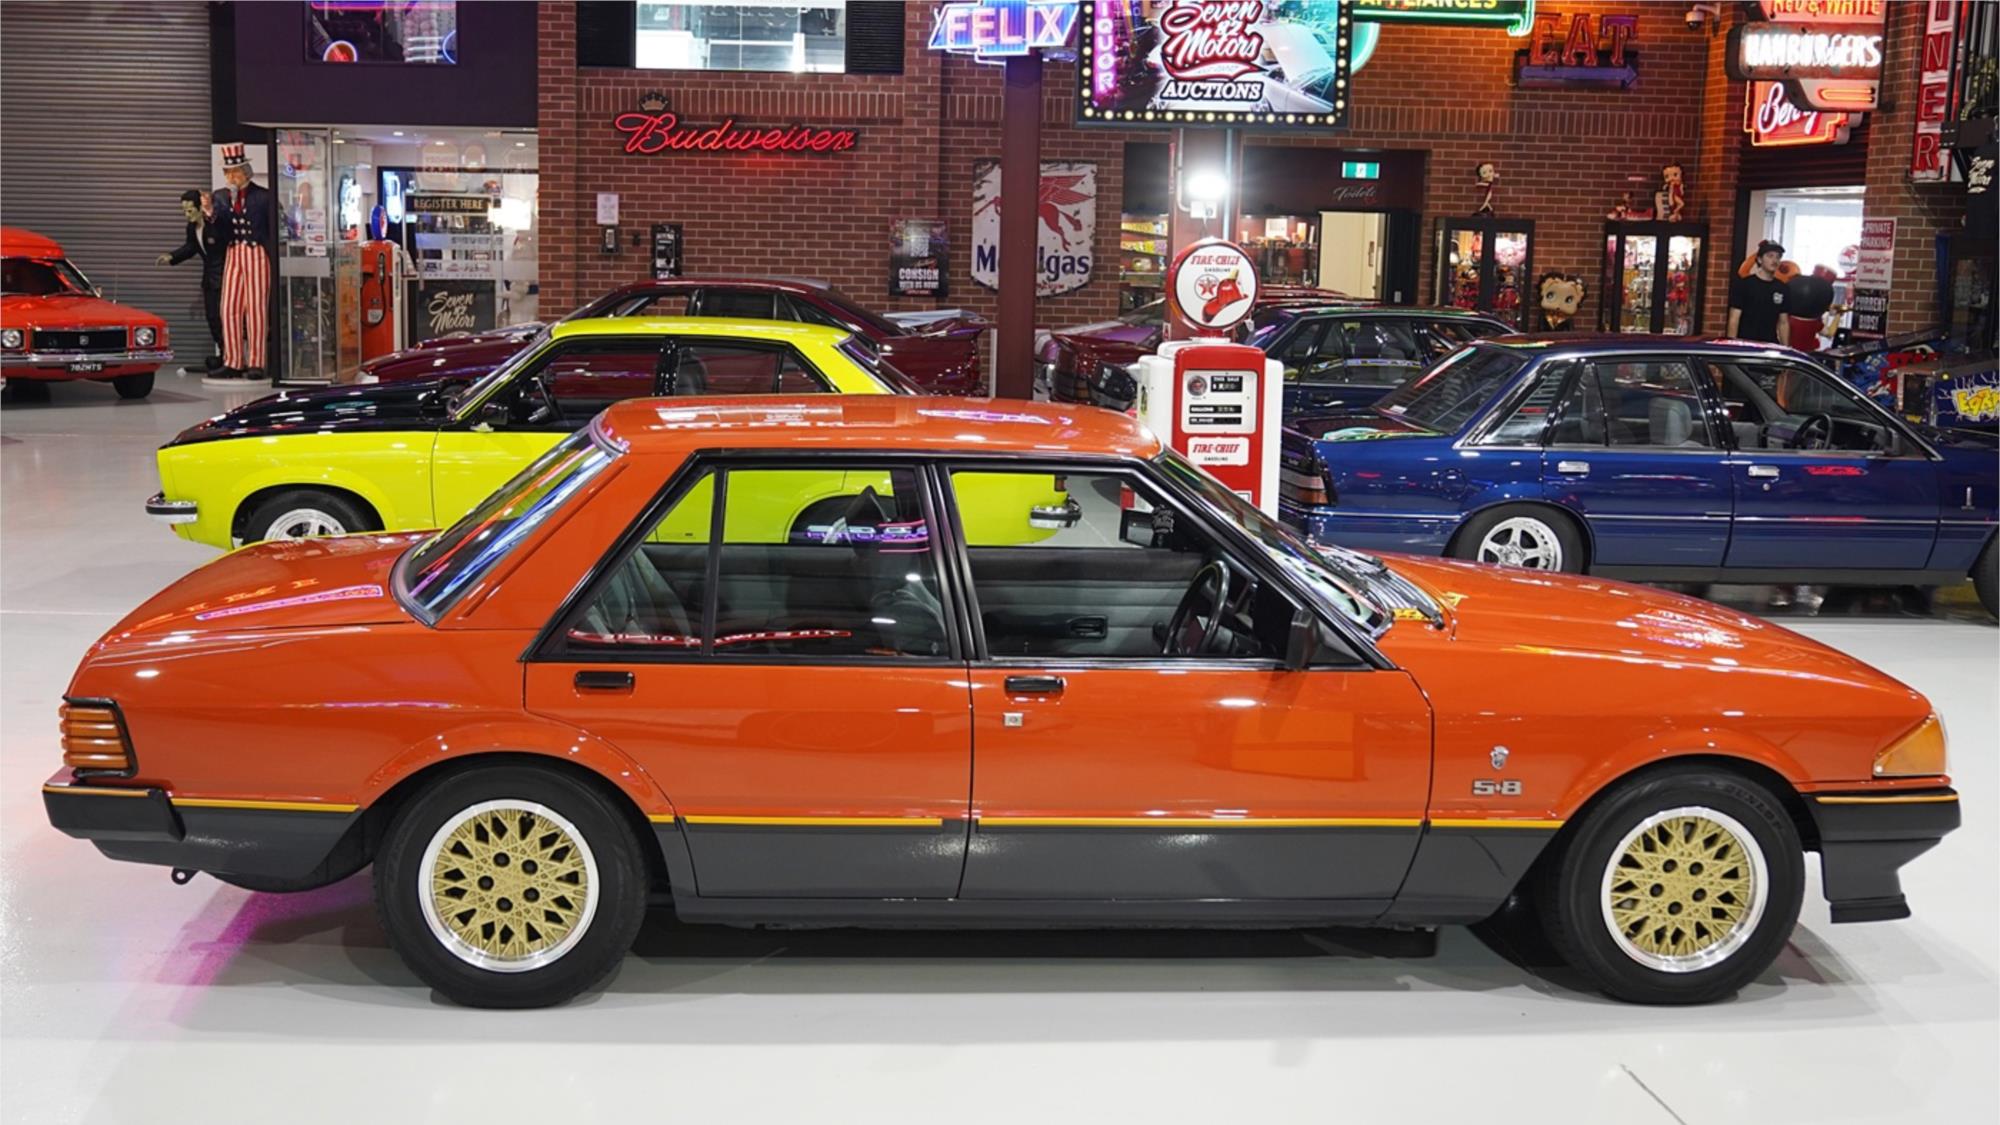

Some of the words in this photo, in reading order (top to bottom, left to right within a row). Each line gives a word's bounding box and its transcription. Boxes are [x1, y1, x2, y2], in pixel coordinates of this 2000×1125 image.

[1165, 0, 1260, 33] Seven
[1773, 0, 1804, 13] RED
[1826, 0, 1881, 15] WHITE
[944, 6, 1064, 46] FELIX
[1215, 20, 1242, 36] 82
[1165, 28, 1260, 67] Motors
[1529, 12, 1638, 67] EAT
[1744, 33, 1882, 67] HAMBURGERS
[1163, 82, 1262, 99] AUCTIONS
[614, 112, 856, 154] Budweiser
[413, 197, 458, 211] REGISTER
[460, 198, 483, 210] HERE
[1864, 222, 1892, 234] PRIVATE
[976, 244, 1090, 282] Mlgas
[1190, 255, 1241, 265] FIRE-CHIEF
[899, 267, 939, 280] CONSIGN
[429, 291, 474, 315] Seven
[430, 311, 476, 334] Motors
[1192, 443, 1240, 453] FIRE-CHIEF
